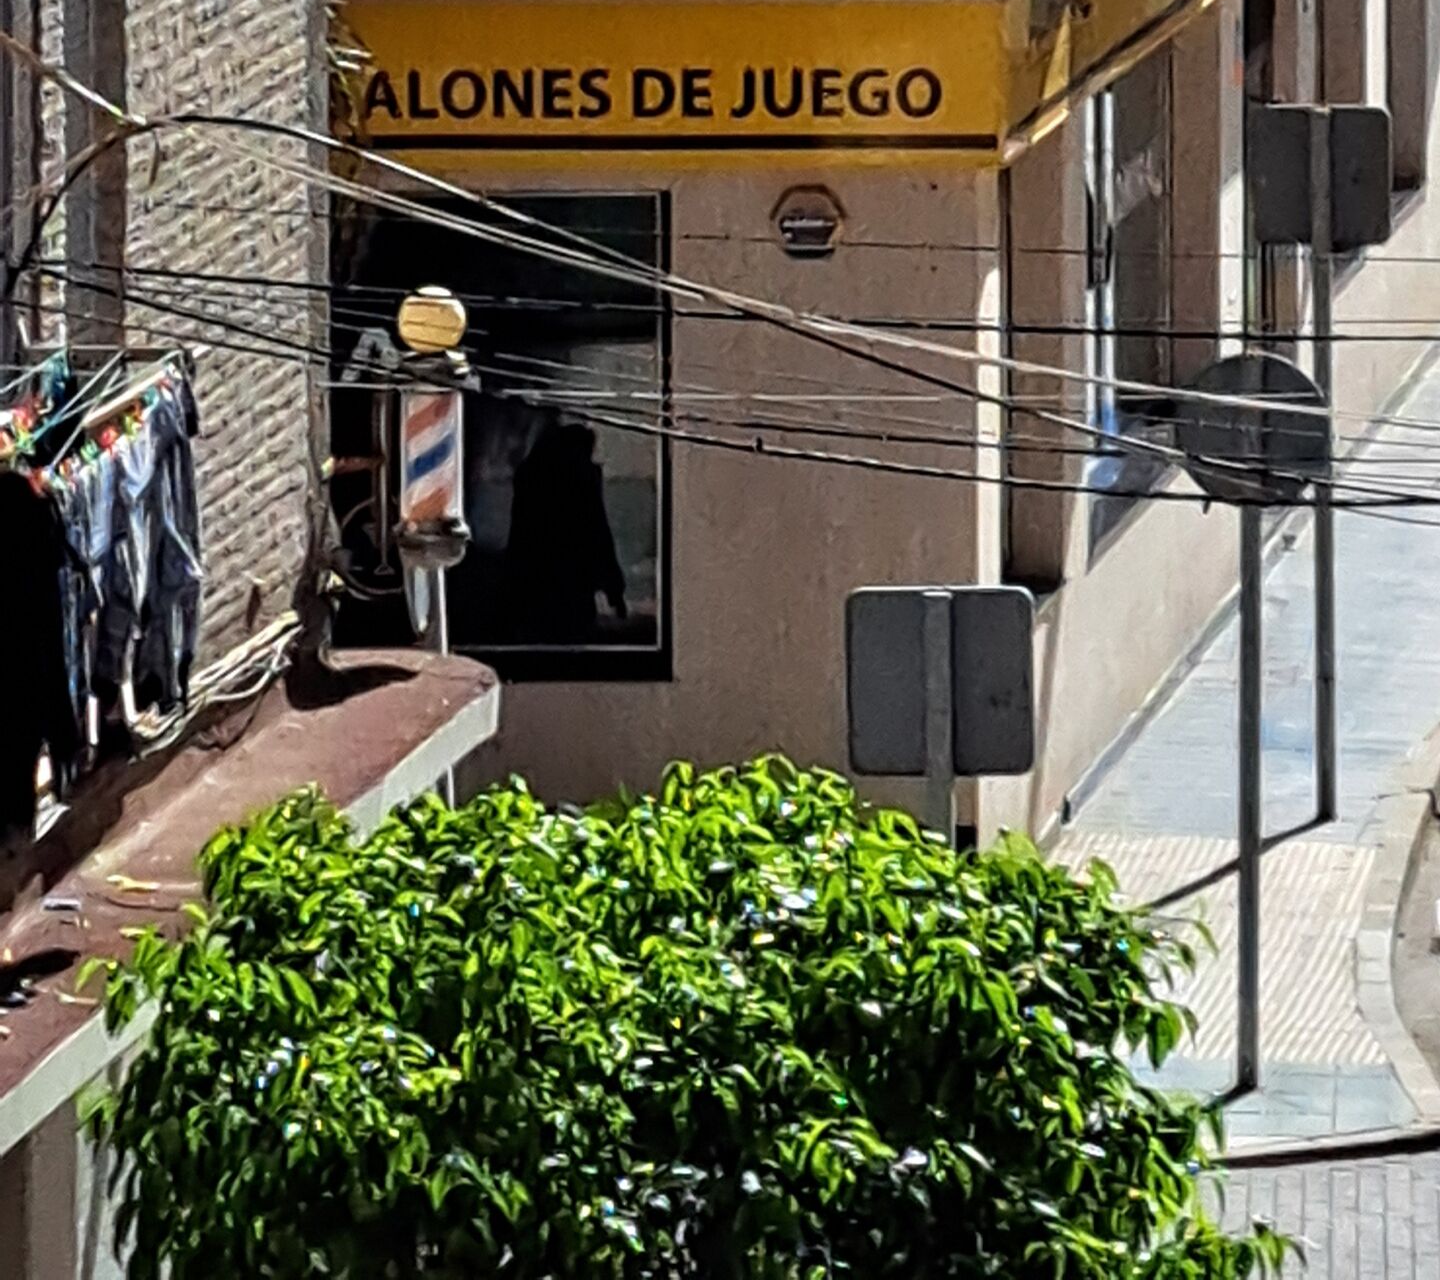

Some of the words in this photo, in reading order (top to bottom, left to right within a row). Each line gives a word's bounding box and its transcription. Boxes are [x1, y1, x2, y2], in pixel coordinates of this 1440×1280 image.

[364, 68, 611, 120] ALONES
[632, 68, 714, 118] DE
[730, 67, 942, 119] JUEGO
